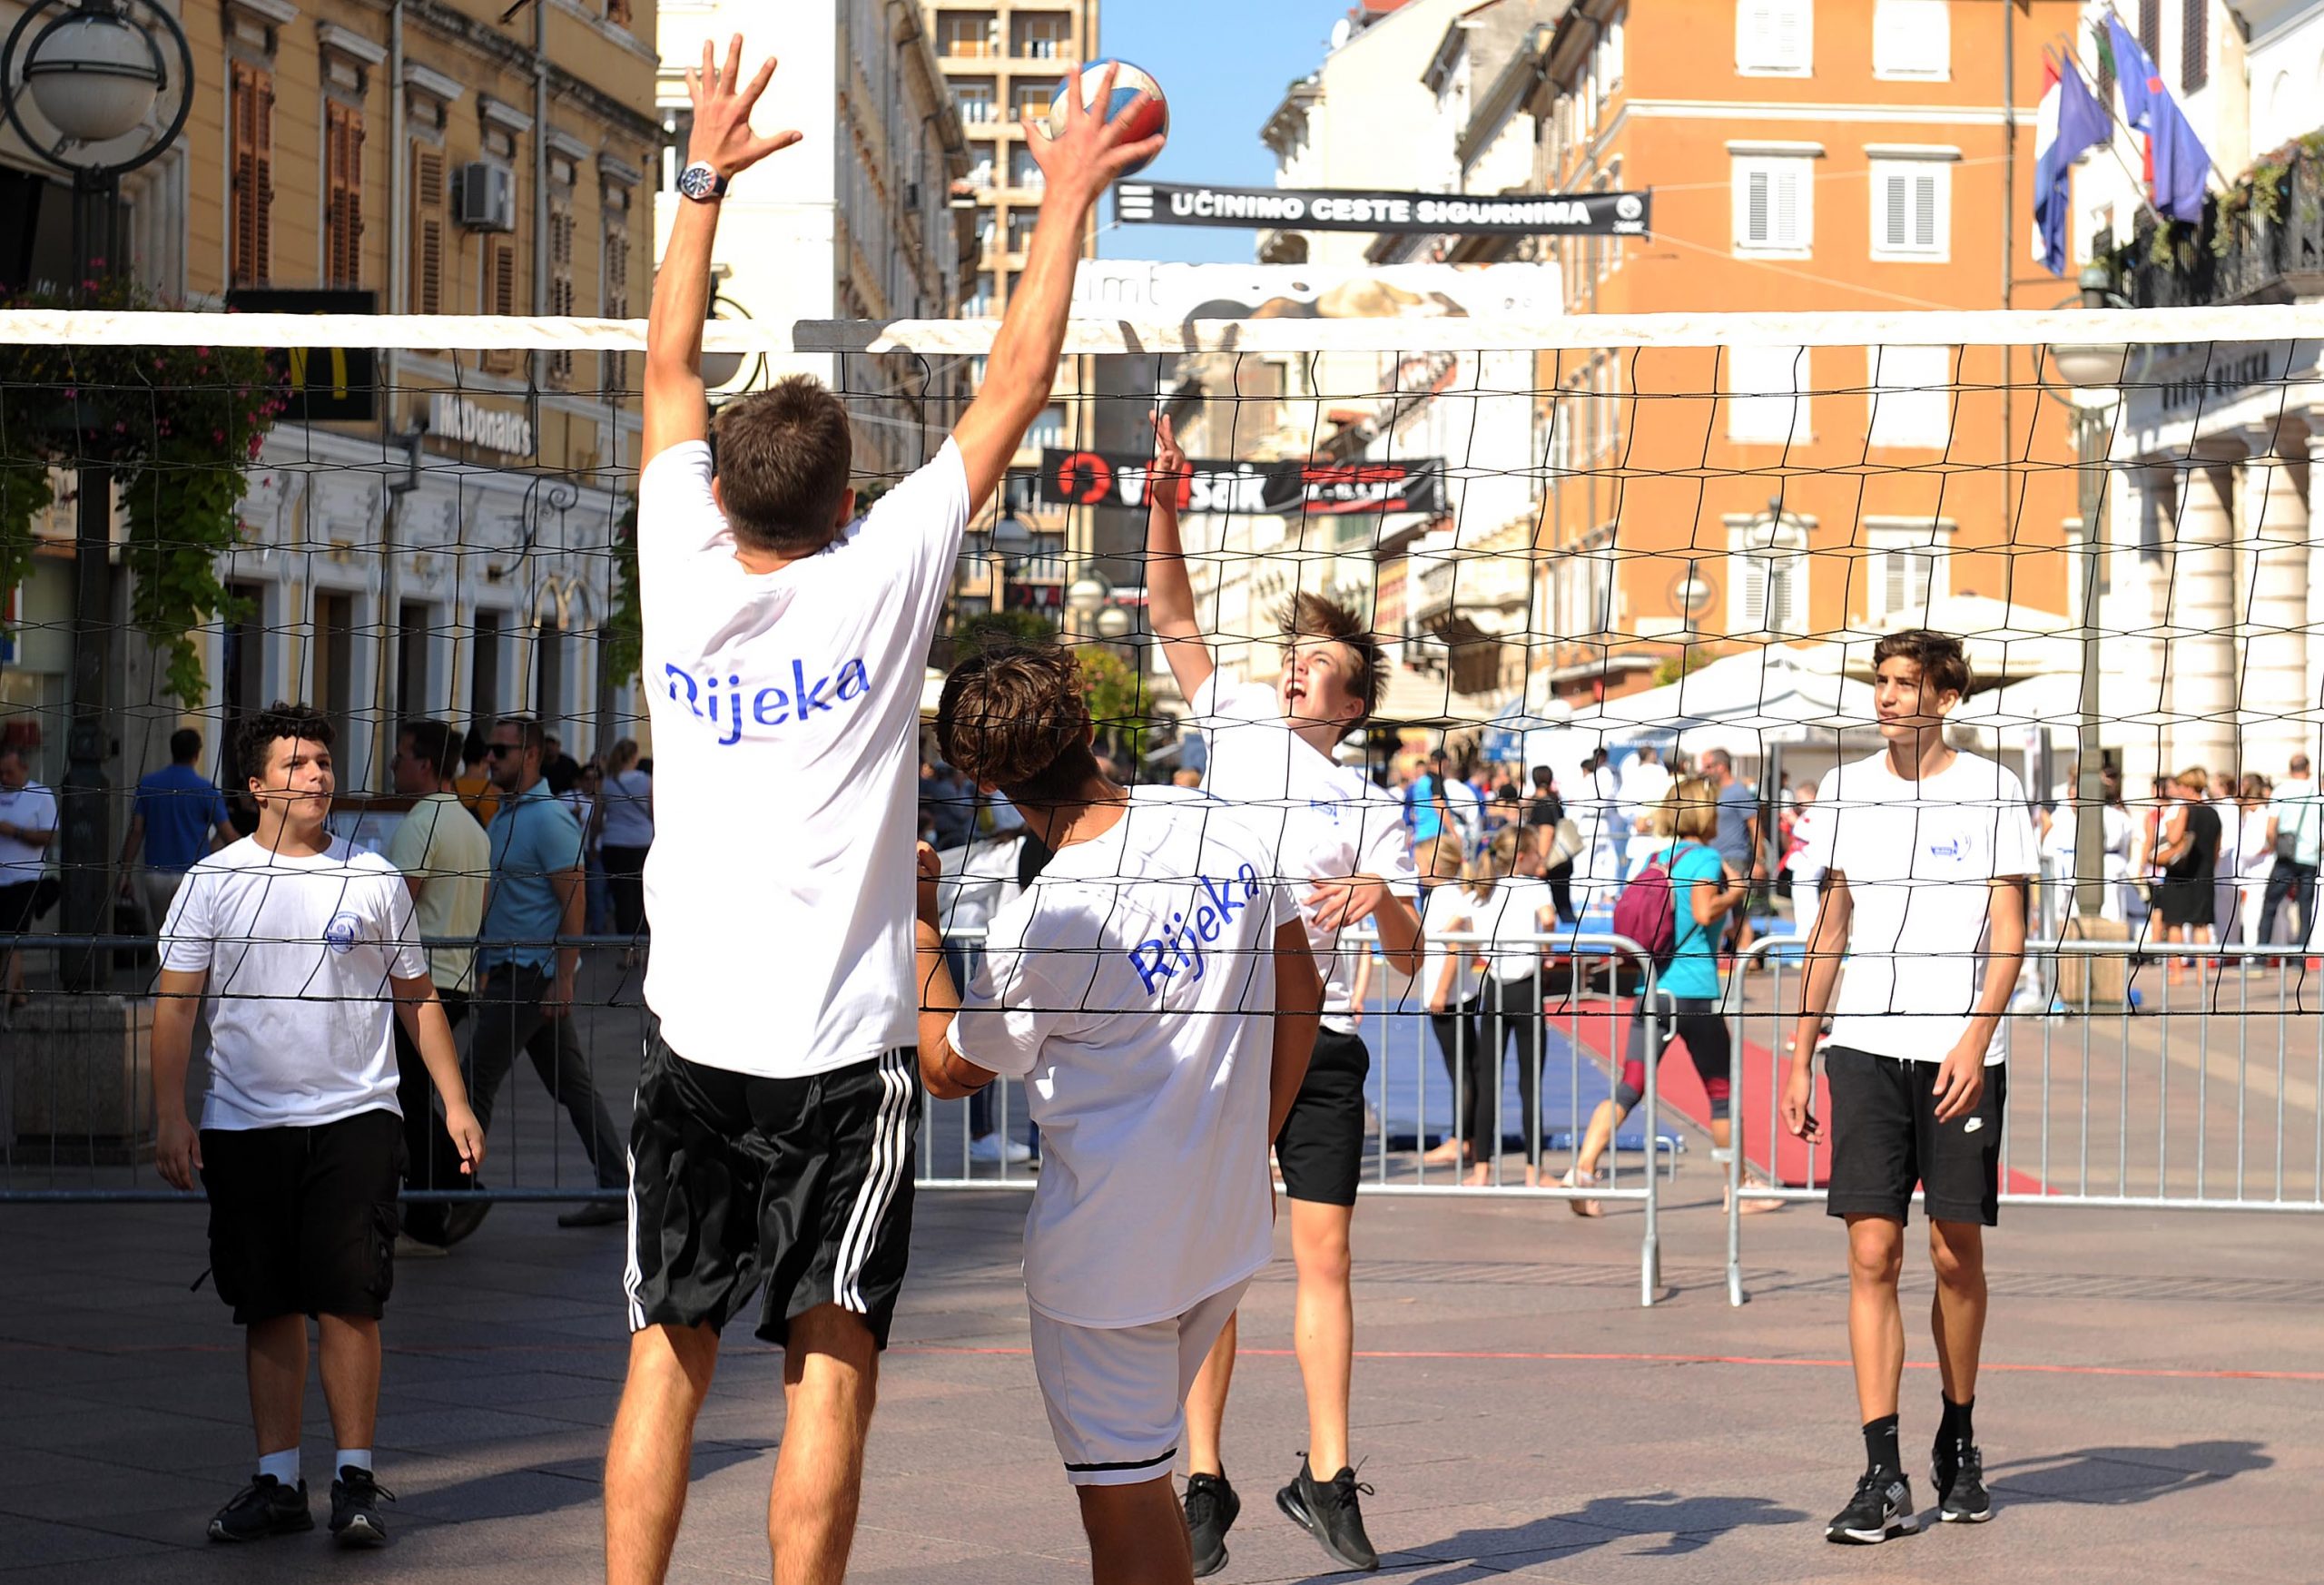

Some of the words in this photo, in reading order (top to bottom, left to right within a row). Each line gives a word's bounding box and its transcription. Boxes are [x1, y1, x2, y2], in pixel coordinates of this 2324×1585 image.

[1170, 189, 1305, 220] UČINIMO
[1310, 197, 1412, 222] CESTE
[1416, 199, 1592, 225] SIGURNIMA
[665, 657, 871, 745] Rijeka
[1128, 862, 1260, 996] Rijeka
